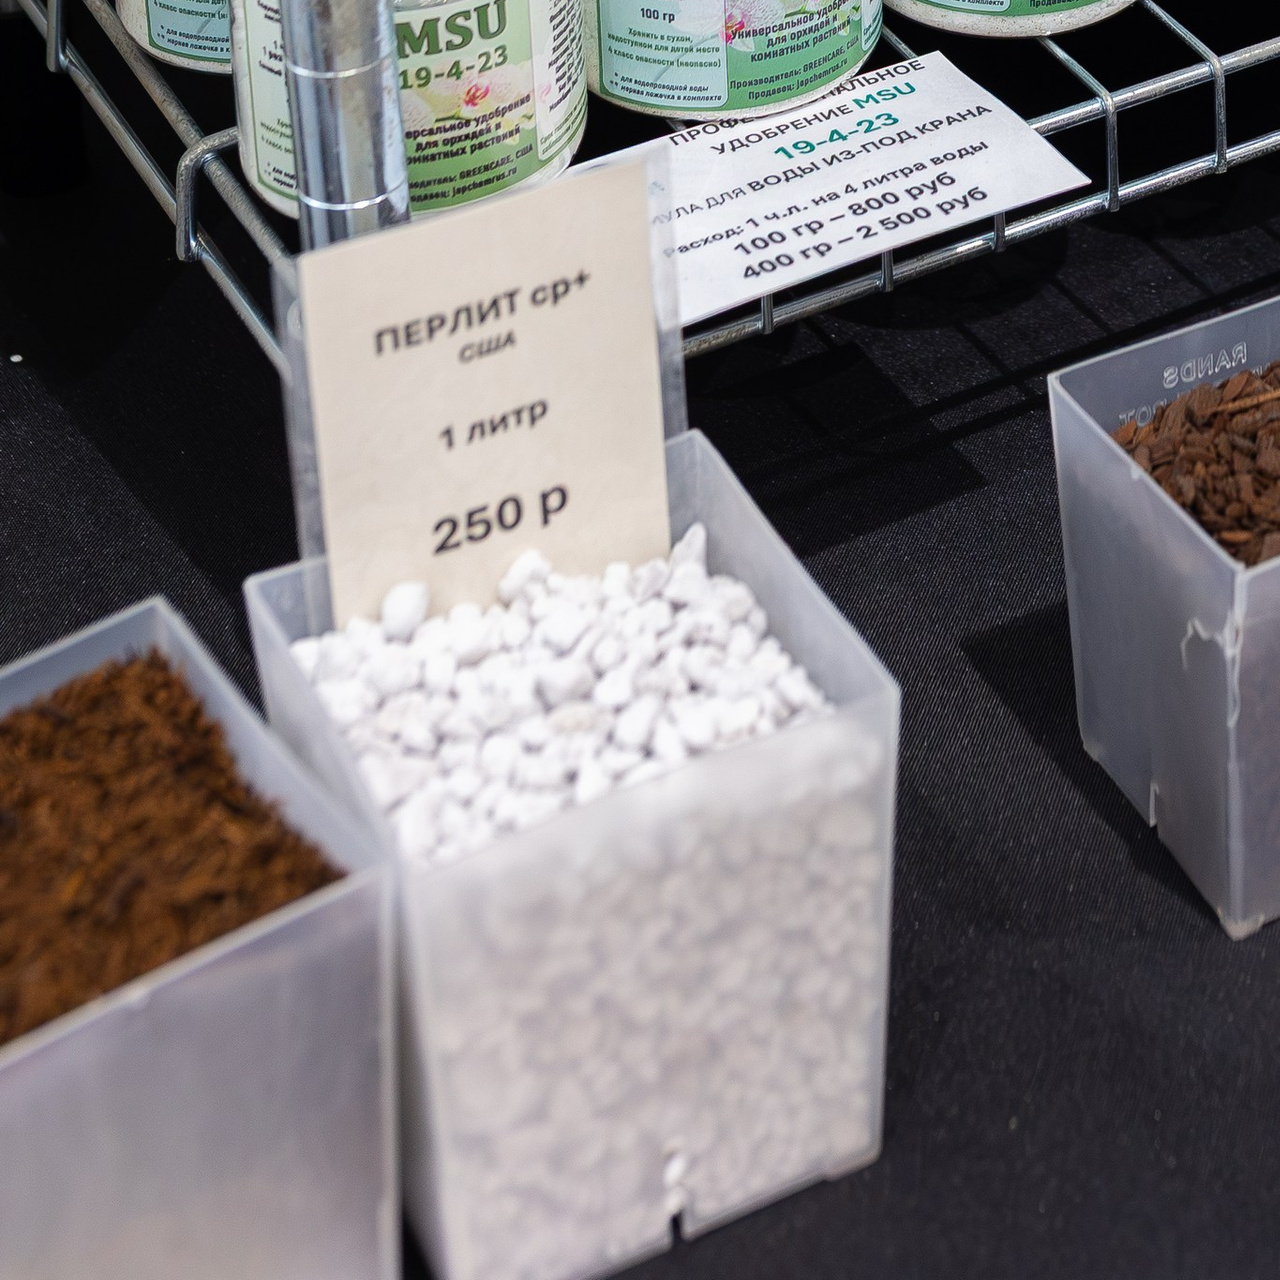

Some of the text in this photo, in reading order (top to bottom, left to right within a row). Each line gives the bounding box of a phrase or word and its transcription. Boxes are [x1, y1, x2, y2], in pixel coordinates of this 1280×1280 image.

[710, 81, 917, 156] УДОБРЕНИЕ MSU
[774, 112, 900, 162] 19-4-23
[375, 269, 591, 356] ПЕРЛИТ ср+
[459, 330, 516, 364] США
[440, 400, 549, 450] 1 литр
[433, 484, 568, 555] 250 р
